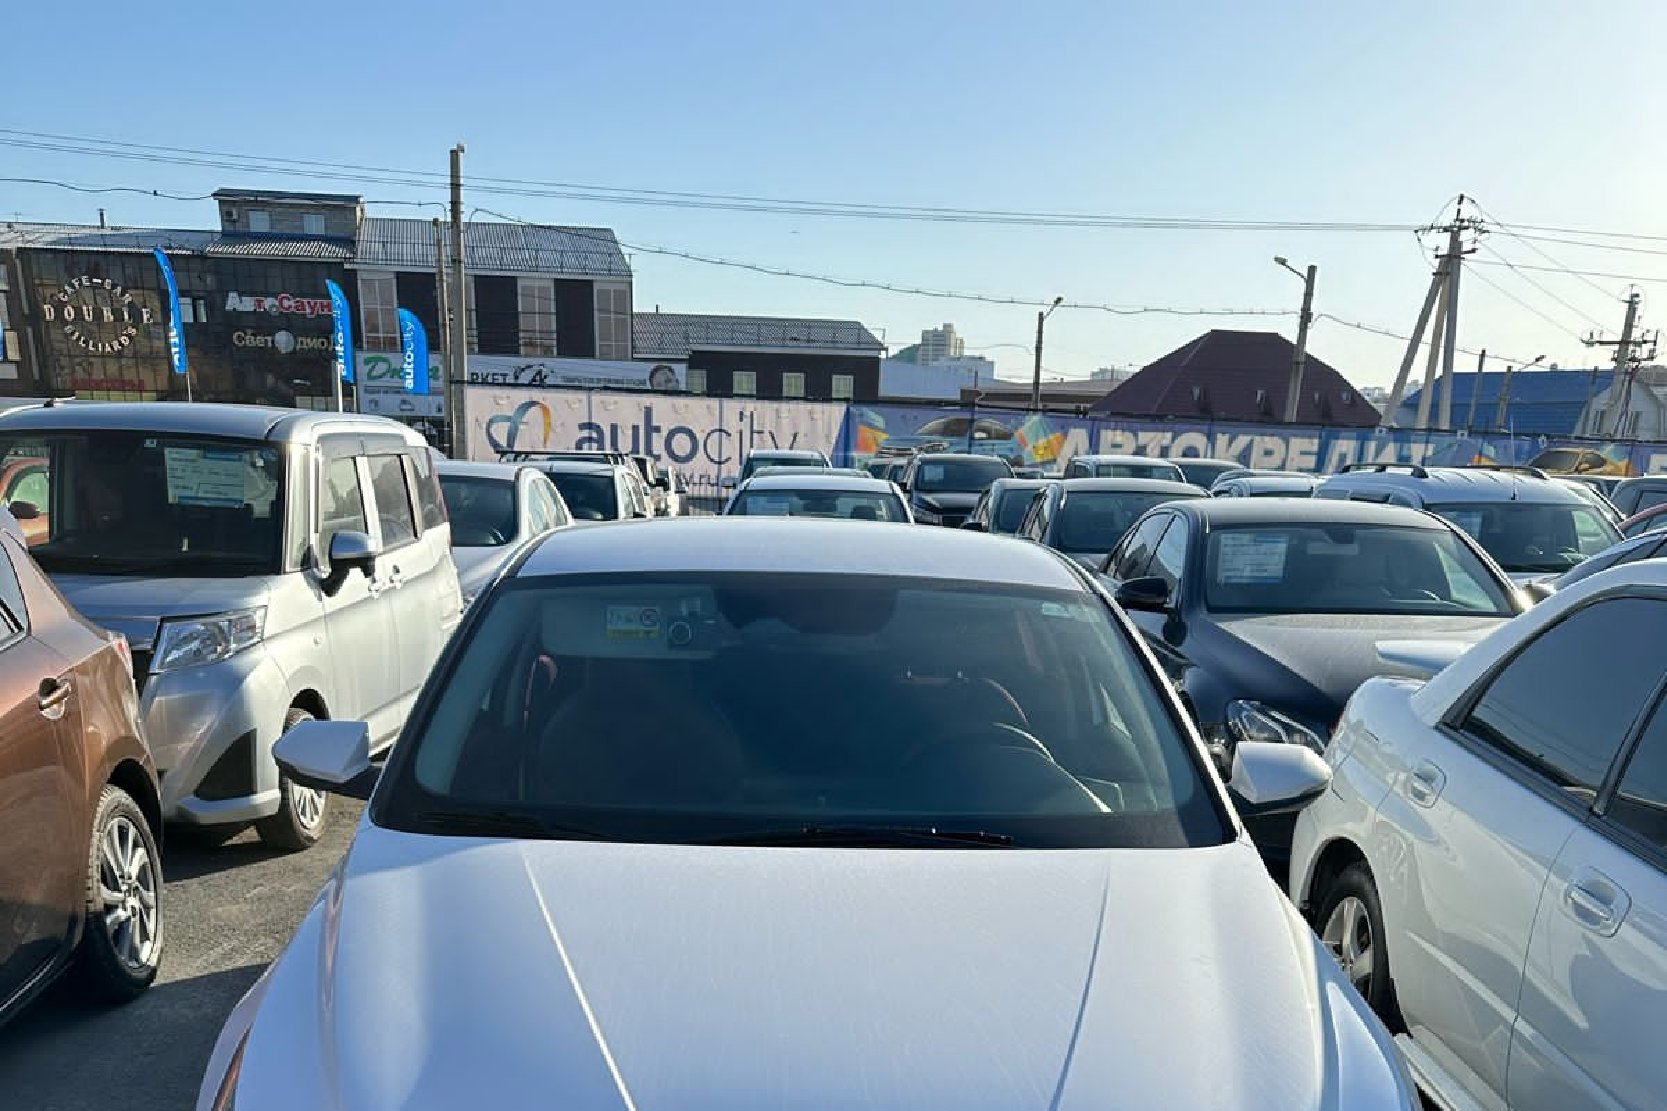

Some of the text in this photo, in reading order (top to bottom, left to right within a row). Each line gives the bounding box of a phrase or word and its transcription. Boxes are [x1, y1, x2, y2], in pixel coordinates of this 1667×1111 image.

[44, 304, 153, 323] DOUBLE
[225, 290, 333, 318] АвтоСаун
[402, 321, 415, 390] autocity
